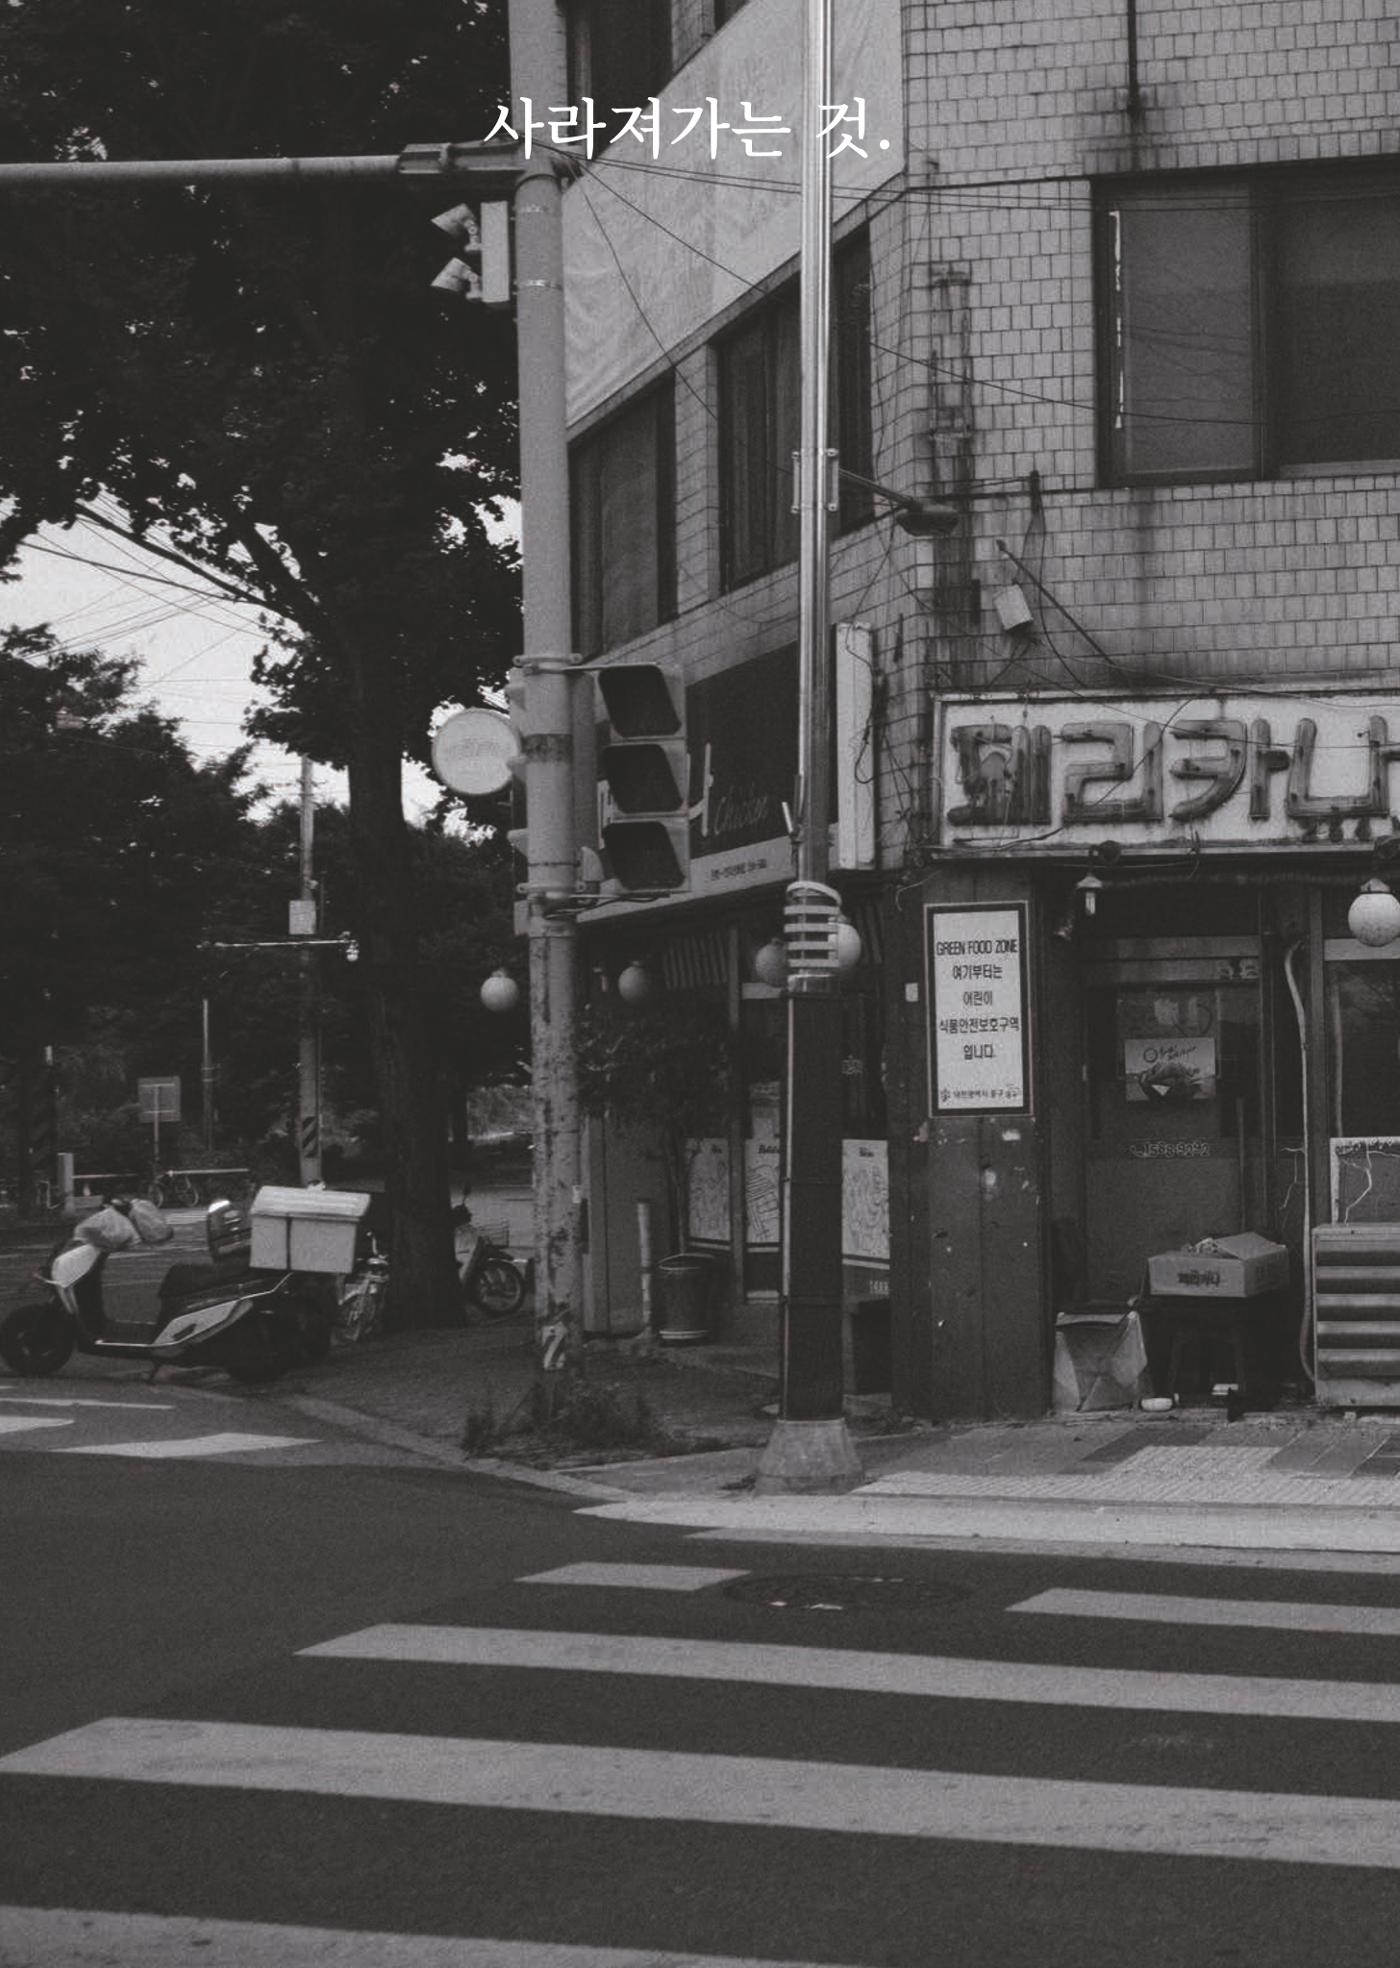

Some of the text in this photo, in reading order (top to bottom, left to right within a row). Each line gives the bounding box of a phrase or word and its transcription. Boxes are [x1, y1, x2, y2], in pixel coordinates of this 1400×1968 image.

[936, 938, 1018, 956] GREEN FOOD ZONE
[952, 963, 1004, 982] 여기부터는
[963, 990, 994, 1007] 어린이
[939, 1014, 1020, 1034] 식품안전보호구역
